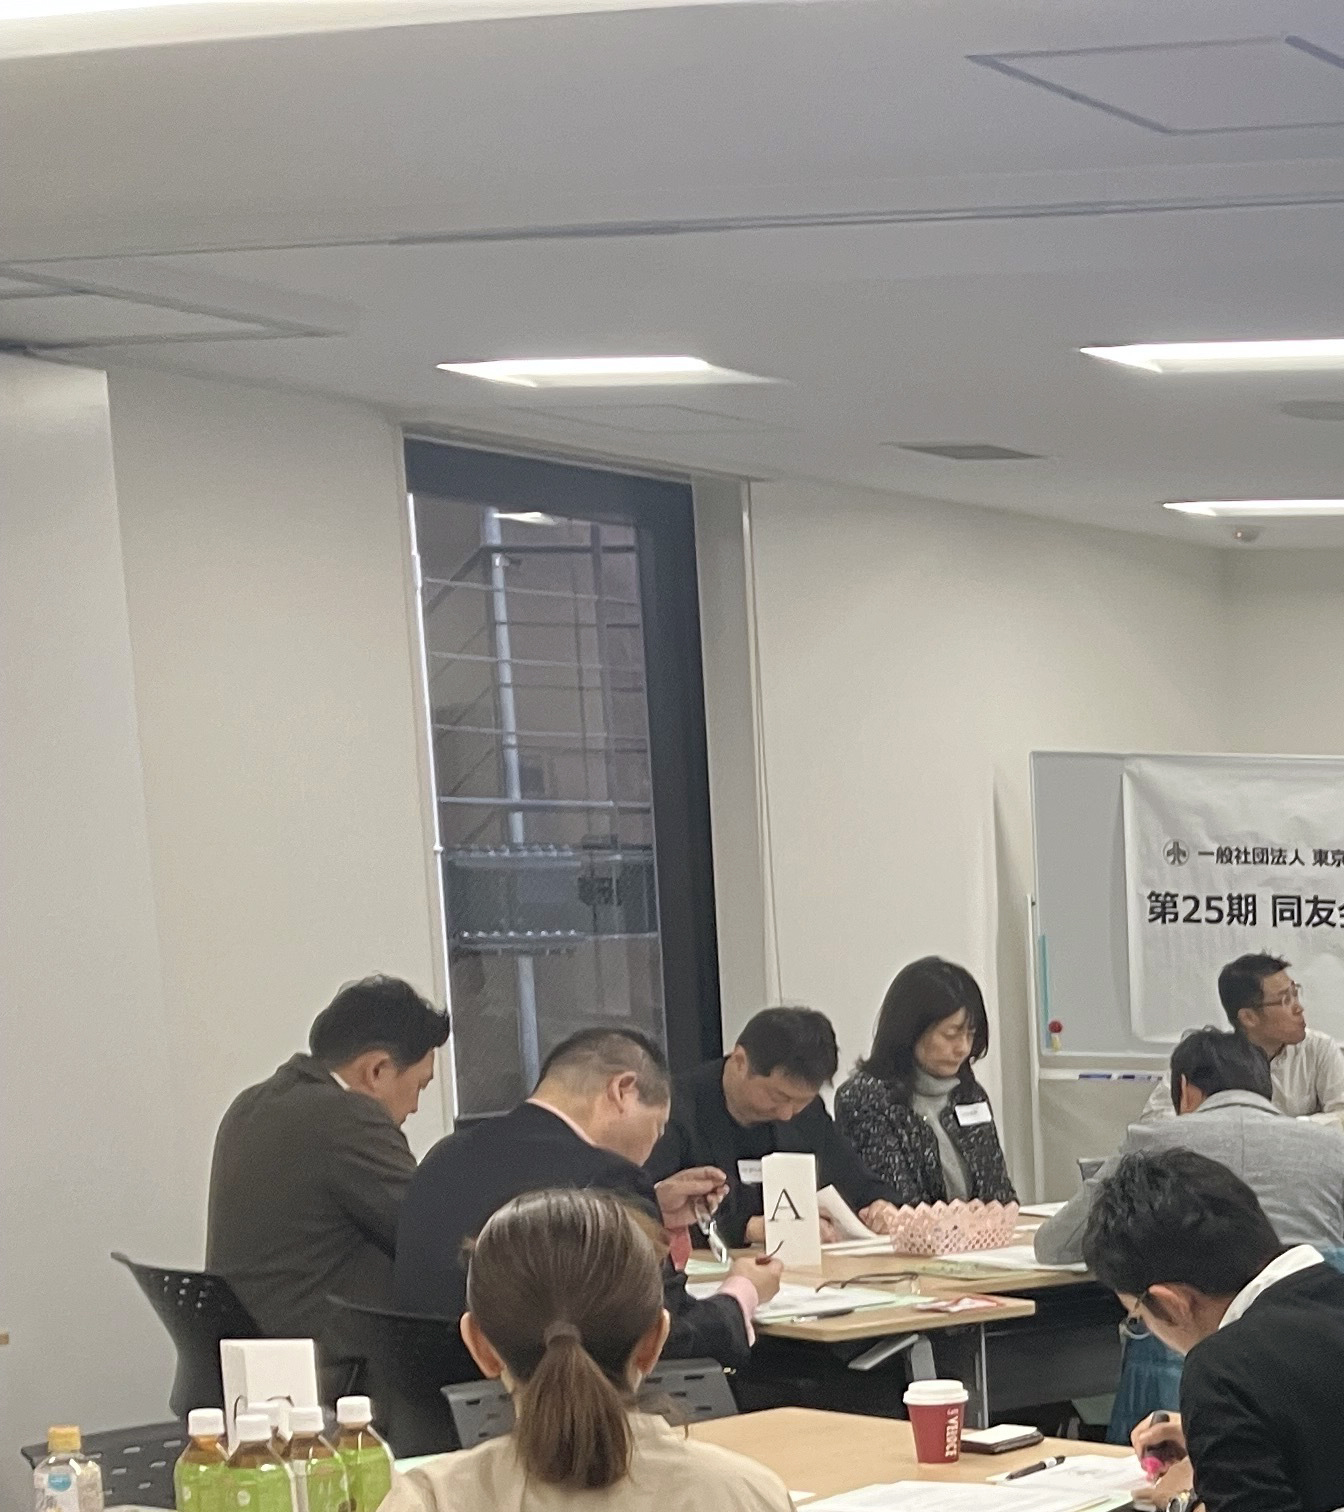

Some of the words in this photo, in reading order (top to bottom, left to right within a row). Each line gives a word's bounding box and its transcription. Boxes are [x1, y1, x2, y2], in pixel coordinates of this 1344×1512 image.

[1197, 846, 1305, 867] 一般社団法人
[1147, 891, 1257, 926] 第25期
[768, 1188, 804, 1222] A
